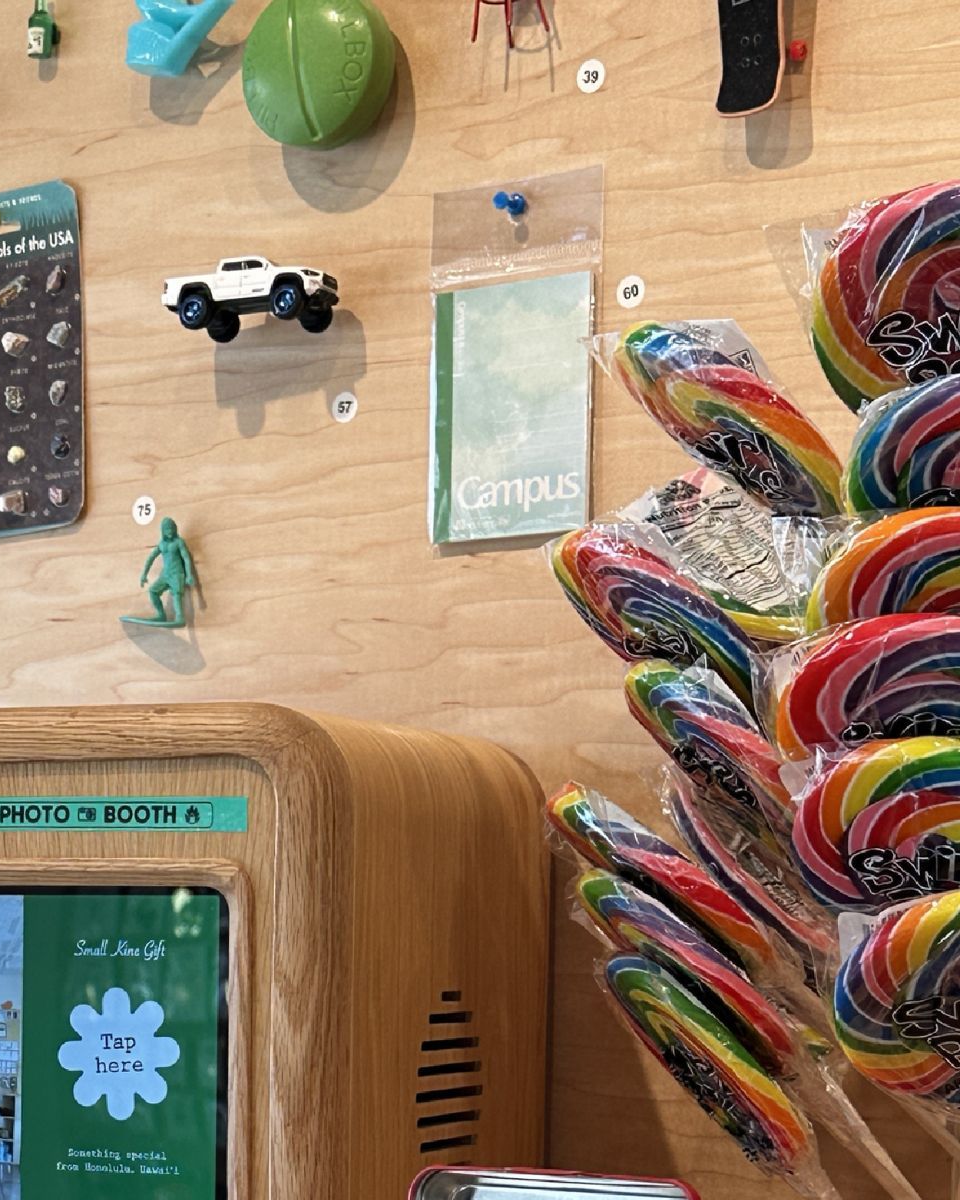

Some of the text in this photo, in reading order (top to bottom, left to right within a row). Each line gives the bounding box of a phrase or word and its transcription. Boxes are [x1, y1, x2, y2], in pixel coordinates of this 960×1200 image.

[583, 70, 599, 84] 39
[14, 236, 26, 254] of
[28, 236, 46, 252] the
[49, 230, 74, 248] USA
[623, 285, 639, 299] 60
[337, 400, 353, 414] 57
[457, 471, 581, 513] Campus
[137, 503, 151, 517] 75
[103, 804, 177, 824] BOOTH
[73, 939, 166, 961] Small Kine Gift
[100, 1033, 136, 1053] Tap
[95, 1056, 144, 1073] here
[67, 1148, 167, 1161] Something special
[56, 1162, 79, 1172] from
